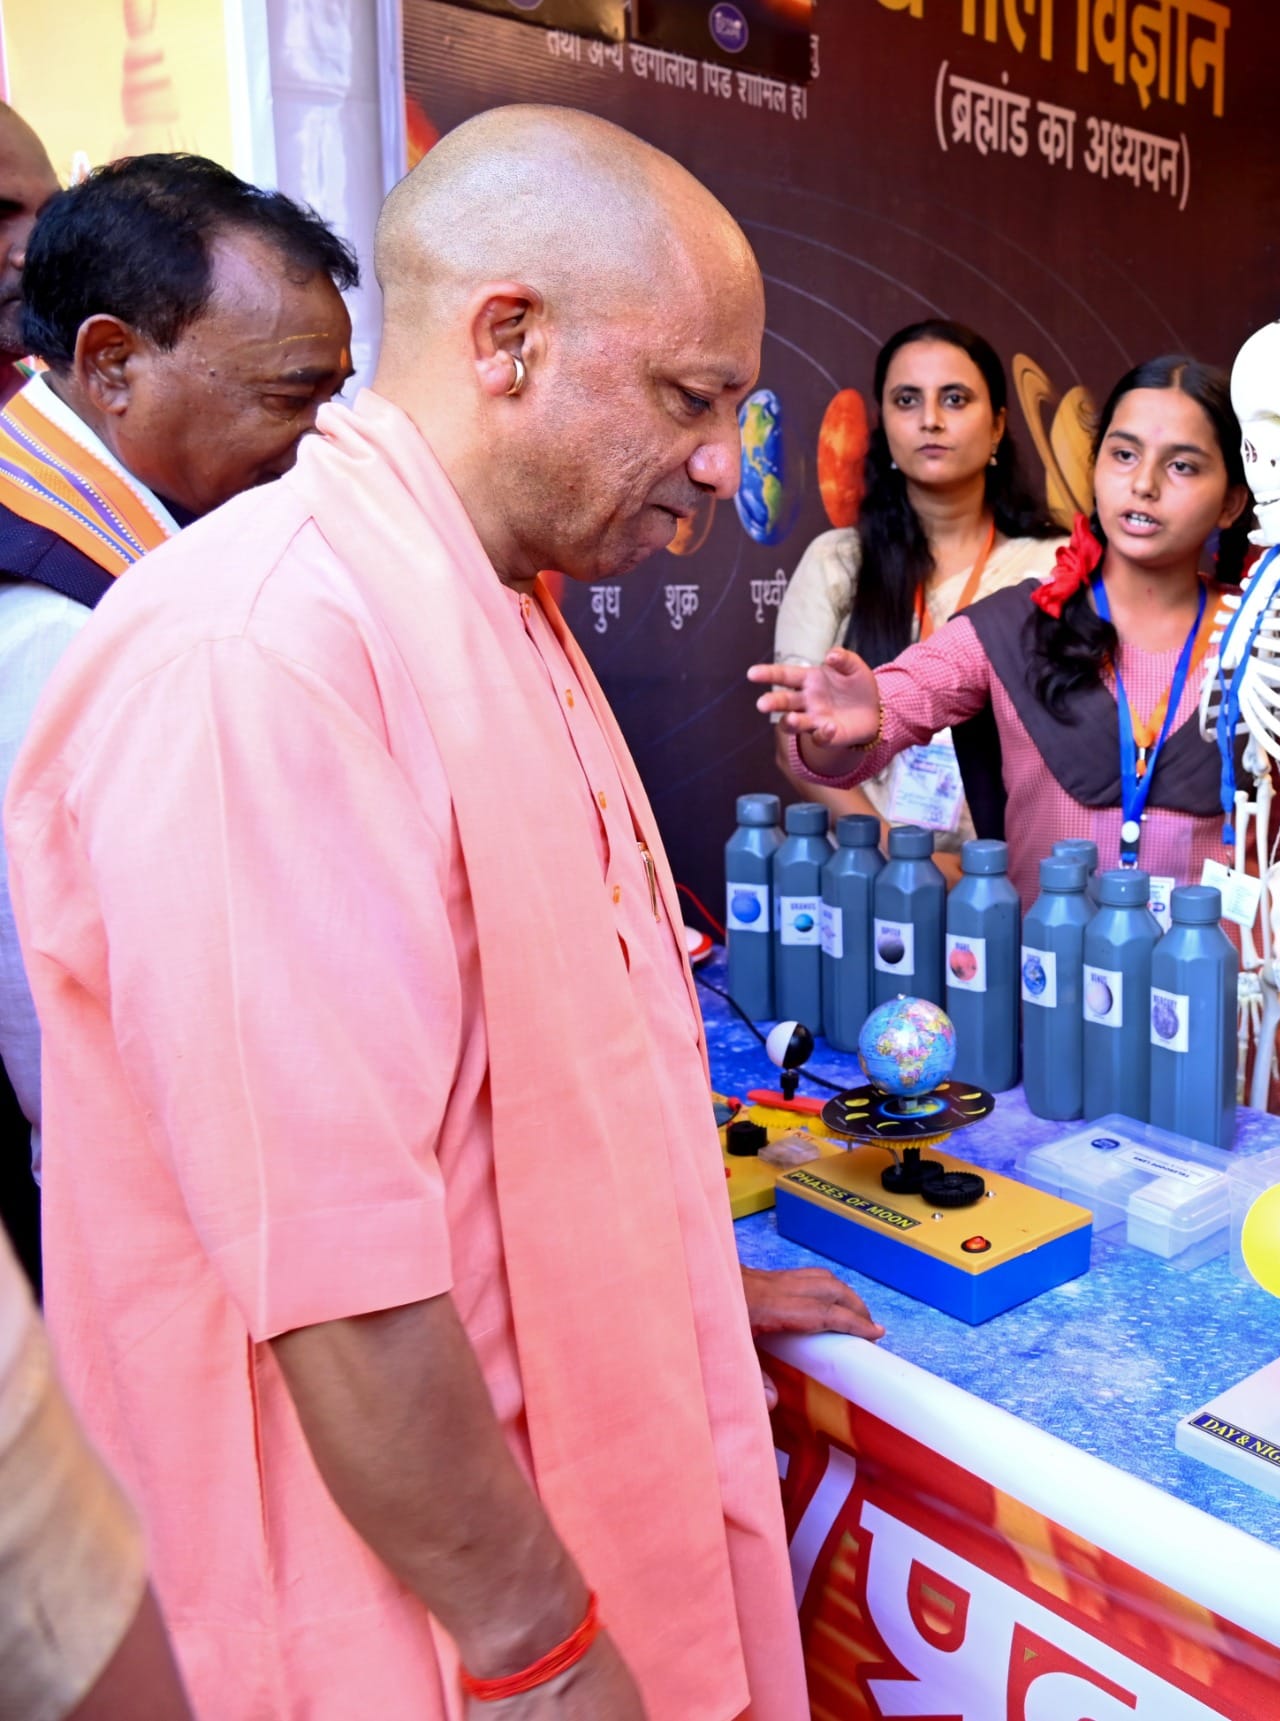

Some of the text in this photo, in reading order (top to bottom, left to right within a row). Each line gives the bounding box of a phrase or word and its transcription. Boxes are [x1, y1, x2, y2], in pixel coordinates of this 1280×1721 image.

[1037, 101, 1077, 170] का
[1084, 116, 1190, 211] अध्ययन)
[590, 585, 621, 633] बुध
[664, 584, 700, 630] शुक्र
[790, 1171, 913, 1228] PHASES OF MOON
[1202, 1418, 1240, 1439] DAY
[1235, 1434, 1250, 1446] &
